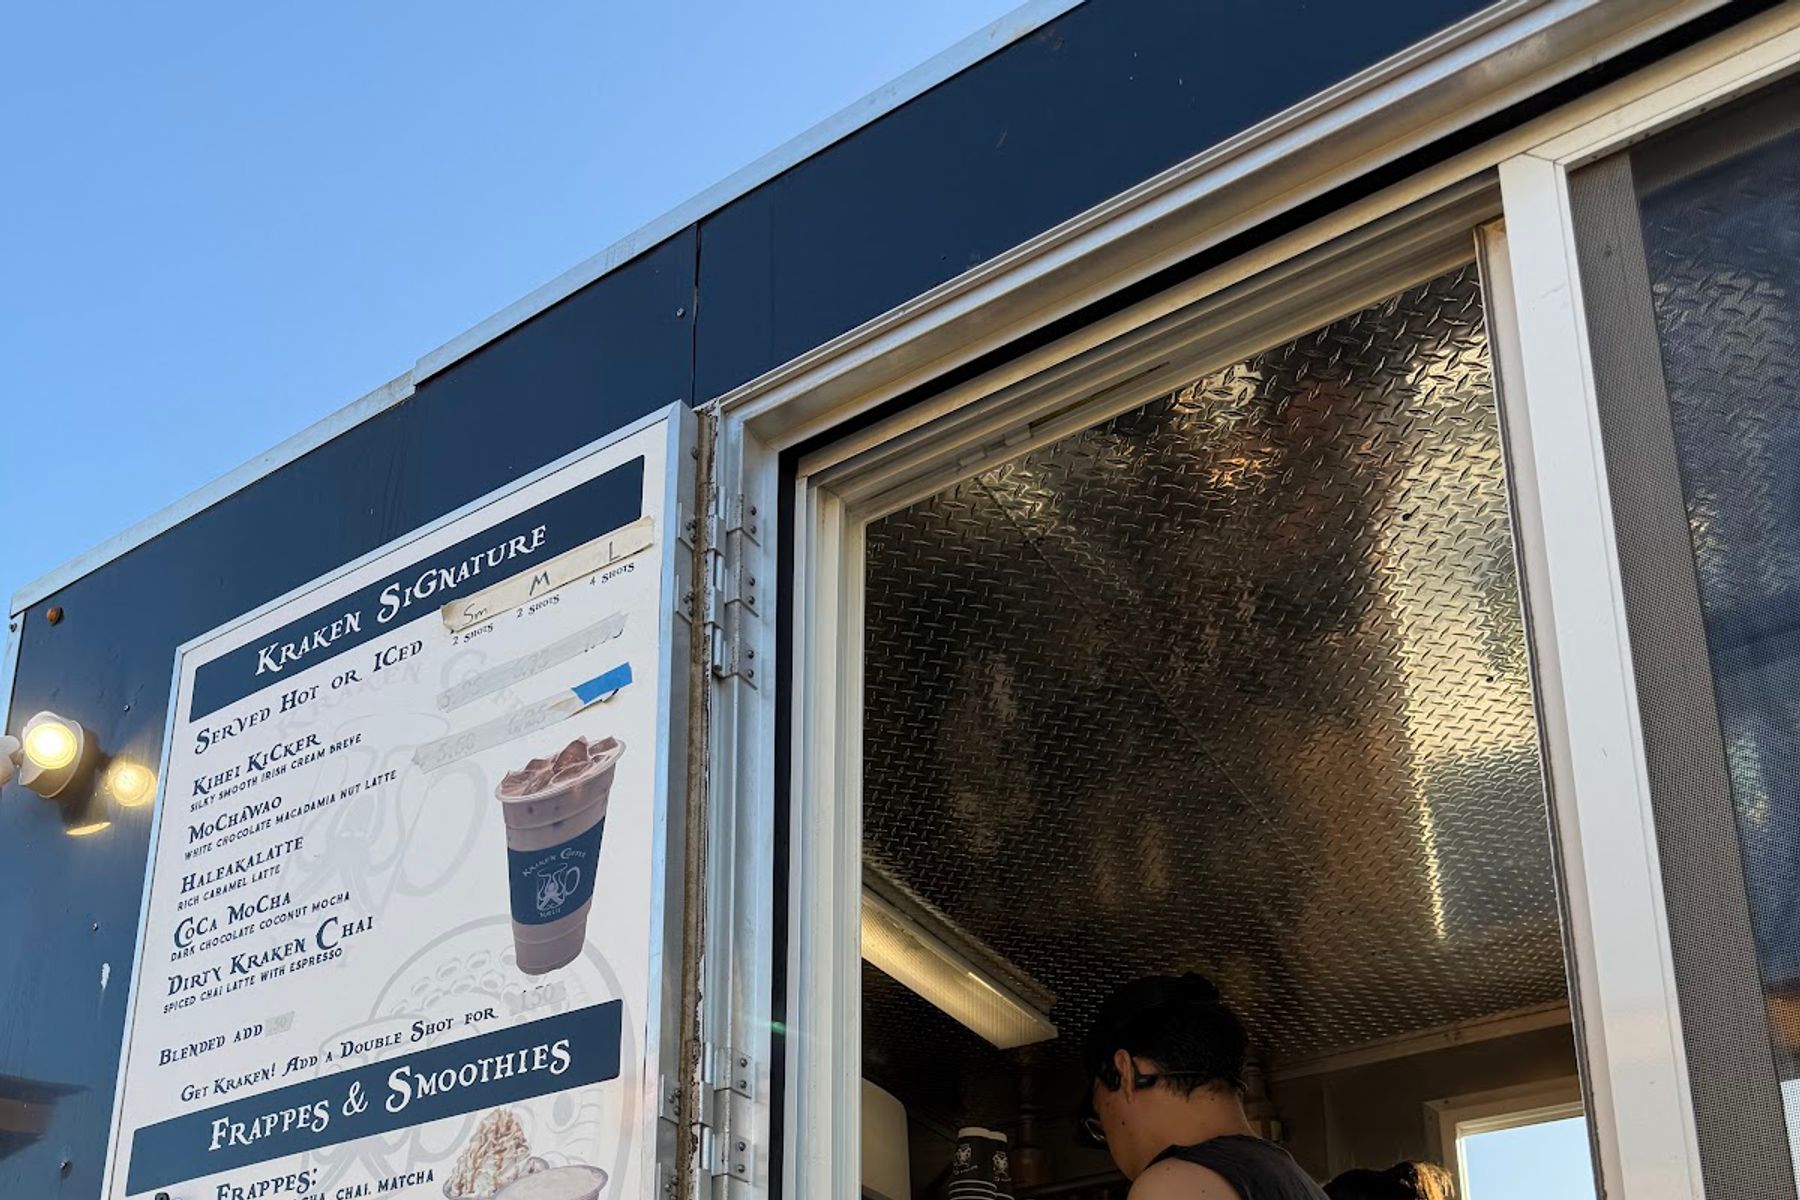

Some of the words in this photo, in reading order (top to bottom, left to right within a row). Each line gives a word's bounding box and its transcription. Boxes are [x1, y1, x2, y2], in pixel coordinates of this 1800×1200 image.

[255, 611, 361, 676] KRAKEN
[377, 525, 547, 623] SIGNATURE
[463, 623, 494, 643] SHOTS
[528, 594, 560, 615] SHOTS
[601, 563, 635, 584] SHOTS
[529, 571, 550, 596] M
[608, 541, 621, 562] L
[194, 708, 271, 755] SERVED
[279, 685, 319, 713] HOT
[331, 670, 362, 689] OR
[373, 640, 423, 672] ICED
[190, 796, 215, 812] SILKY
[218, 777, 258, 800] SMOOTH
[261, 766, 287, 783] IRISH
[291, 748, 325, 770] CREAM
[329, 733, 362, 754] BREVE
[192, 766, 240, 796] KIHEI
[246, 734, 320, 773] KICKER
[184, 842, 212, 861] WHITE
[216, 818, 272, 848] CHOCOLATE
[275, 793, 336, 825] MACADAMIA
[340, 783, 361, 800] NUT
[364, 769, 397, 790] LATTE
[187, 796, 282, 844] MOCHAWAO
[177, 895, 199, 911] RICH
[203, 877, 247, 901] CARAMEL
[251, 864, 281, 884] LATTE
[180, 836, 304, 895] HALEAKALATTE
[170, 945, 195, 962] DARK
[200, 924, 255, 952] CHOCOLATE
[259, 906, 307, 930] COCONUT
[311, 890, 350, 912] MOCHA
[173, 916, 218, 949] COCA
[227, 891, 291, 925] MOCHA
[163, 995, 196, 1014] SPICED
[200, 985, 223, 1002] CHAI
[226, 975, 256, 993] LATTE
[260, 965, 285, 982] WITH
[289, 947, 343, 972] ESPRESSO
[167, 966, 222, 996] DIRTY
[230, 938, 306, 976] KRAKEN
[315, 915, 374, 950] CHAI
[158, 1035, 226, 1066] BLENDED
[233, 1024, 263, 1043] ADD
[181, 1085, 209, 1102] GET
[213, 1063, 276, 1095] KRAKEN!
[282, 1055, 318, 1077] ADD
[325, 1051, 333, 1063] A
[340, 1032, 402, 1059] DOUBLE
[411, 1017, 455, 1043] SHOT
[464, 1008, 499, 1025] FOR
[208, 1100, 330, 1151] FRAPPES
[342, 1081, 368, 1117] &
[385, 1039, 571, 1113] SMOOTHIES
[378, 1169, 434, 1193] MATCHA
